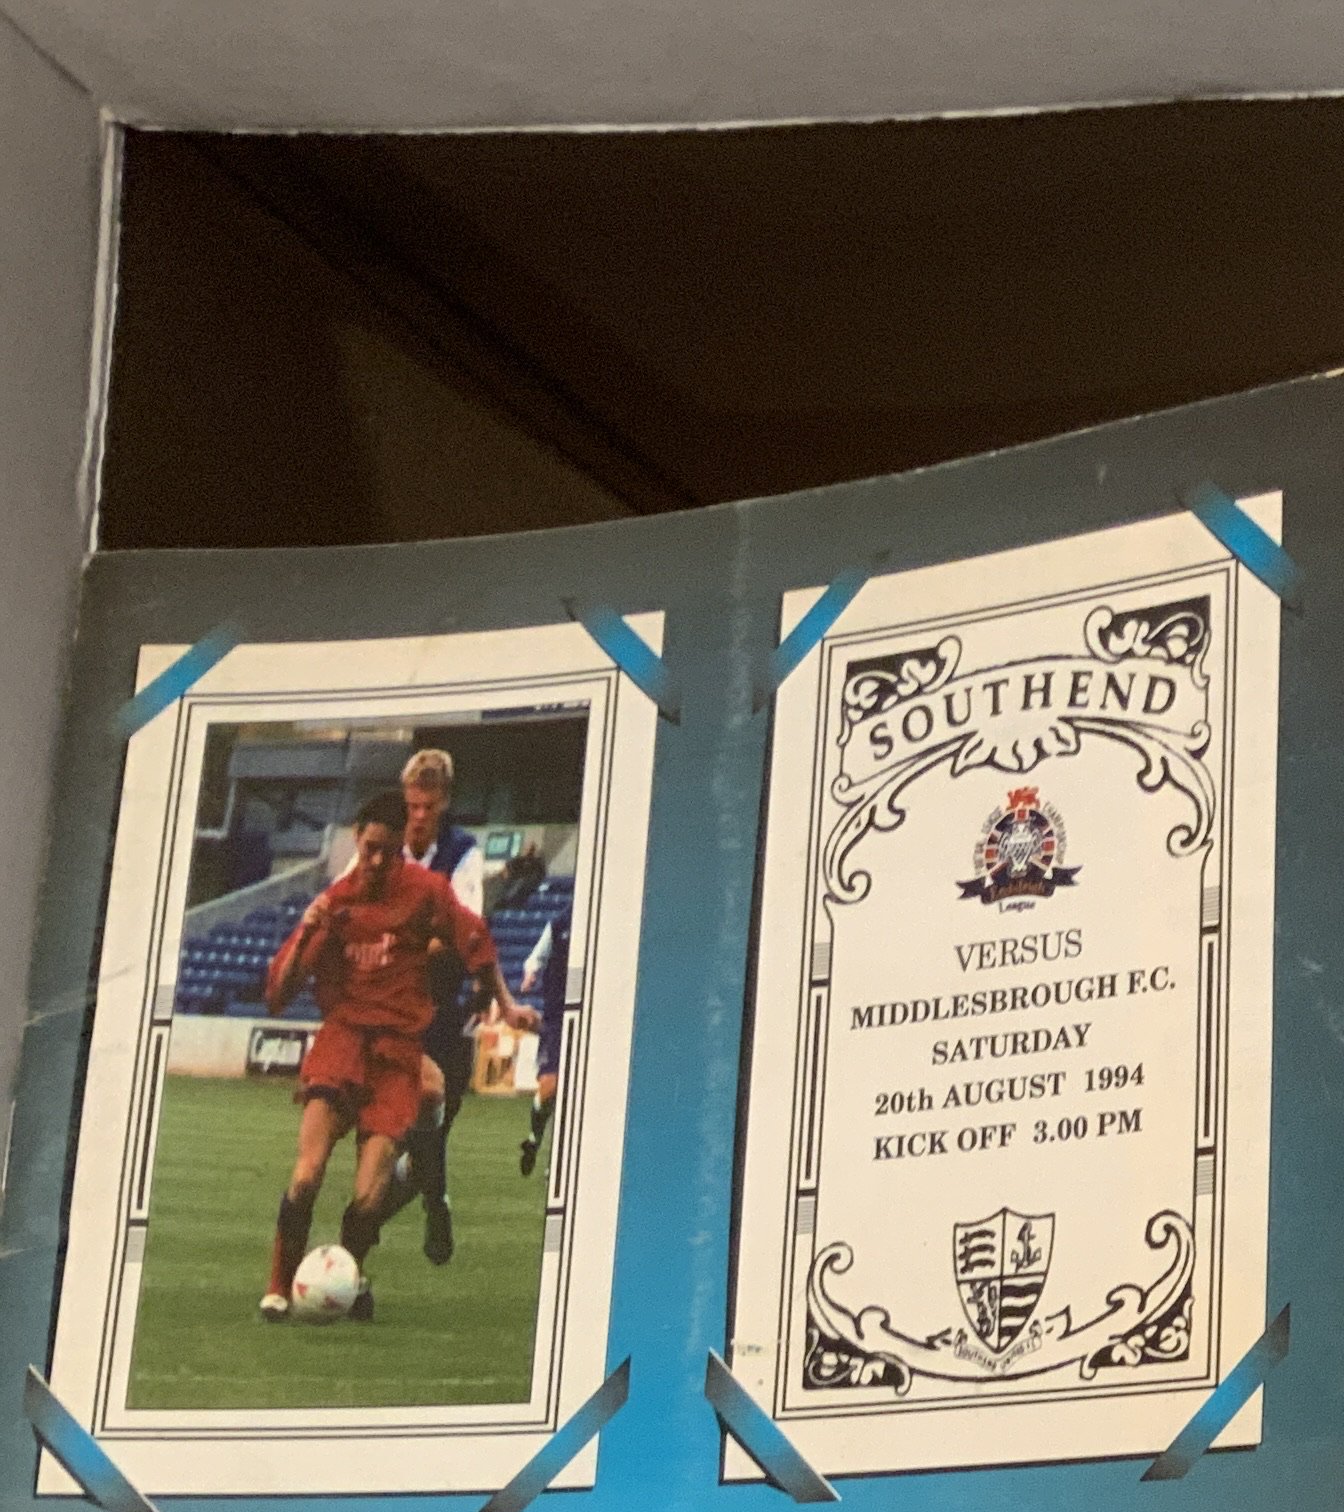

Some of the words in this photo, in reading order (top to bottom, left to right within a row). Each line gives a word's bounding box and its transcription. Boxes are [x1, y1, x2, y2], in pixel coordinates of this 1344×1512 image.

[869, 671, 1176, 760] SOUTHEND
[955, 929, 1082, 971] VERSUS
[851, 974, 1117, 1029] MIDDLESBROUGH
[1128, 967, 1175, 994] F.C.
[932, 1023, 1091, 1064] SATURDAY
[875, 1088, 933, 1115] 20th
[943, 1072, 1066, 1108] AUGUST
[1087, 1064, 1143, 1091] 1994
[874, 1131, 947, 1160] KICK
[957, 1124, 1016, 1150] OFF
[1034, 1117, 1088, 1143] 3.00
[1098, 1109, 1141, 1136] PM
